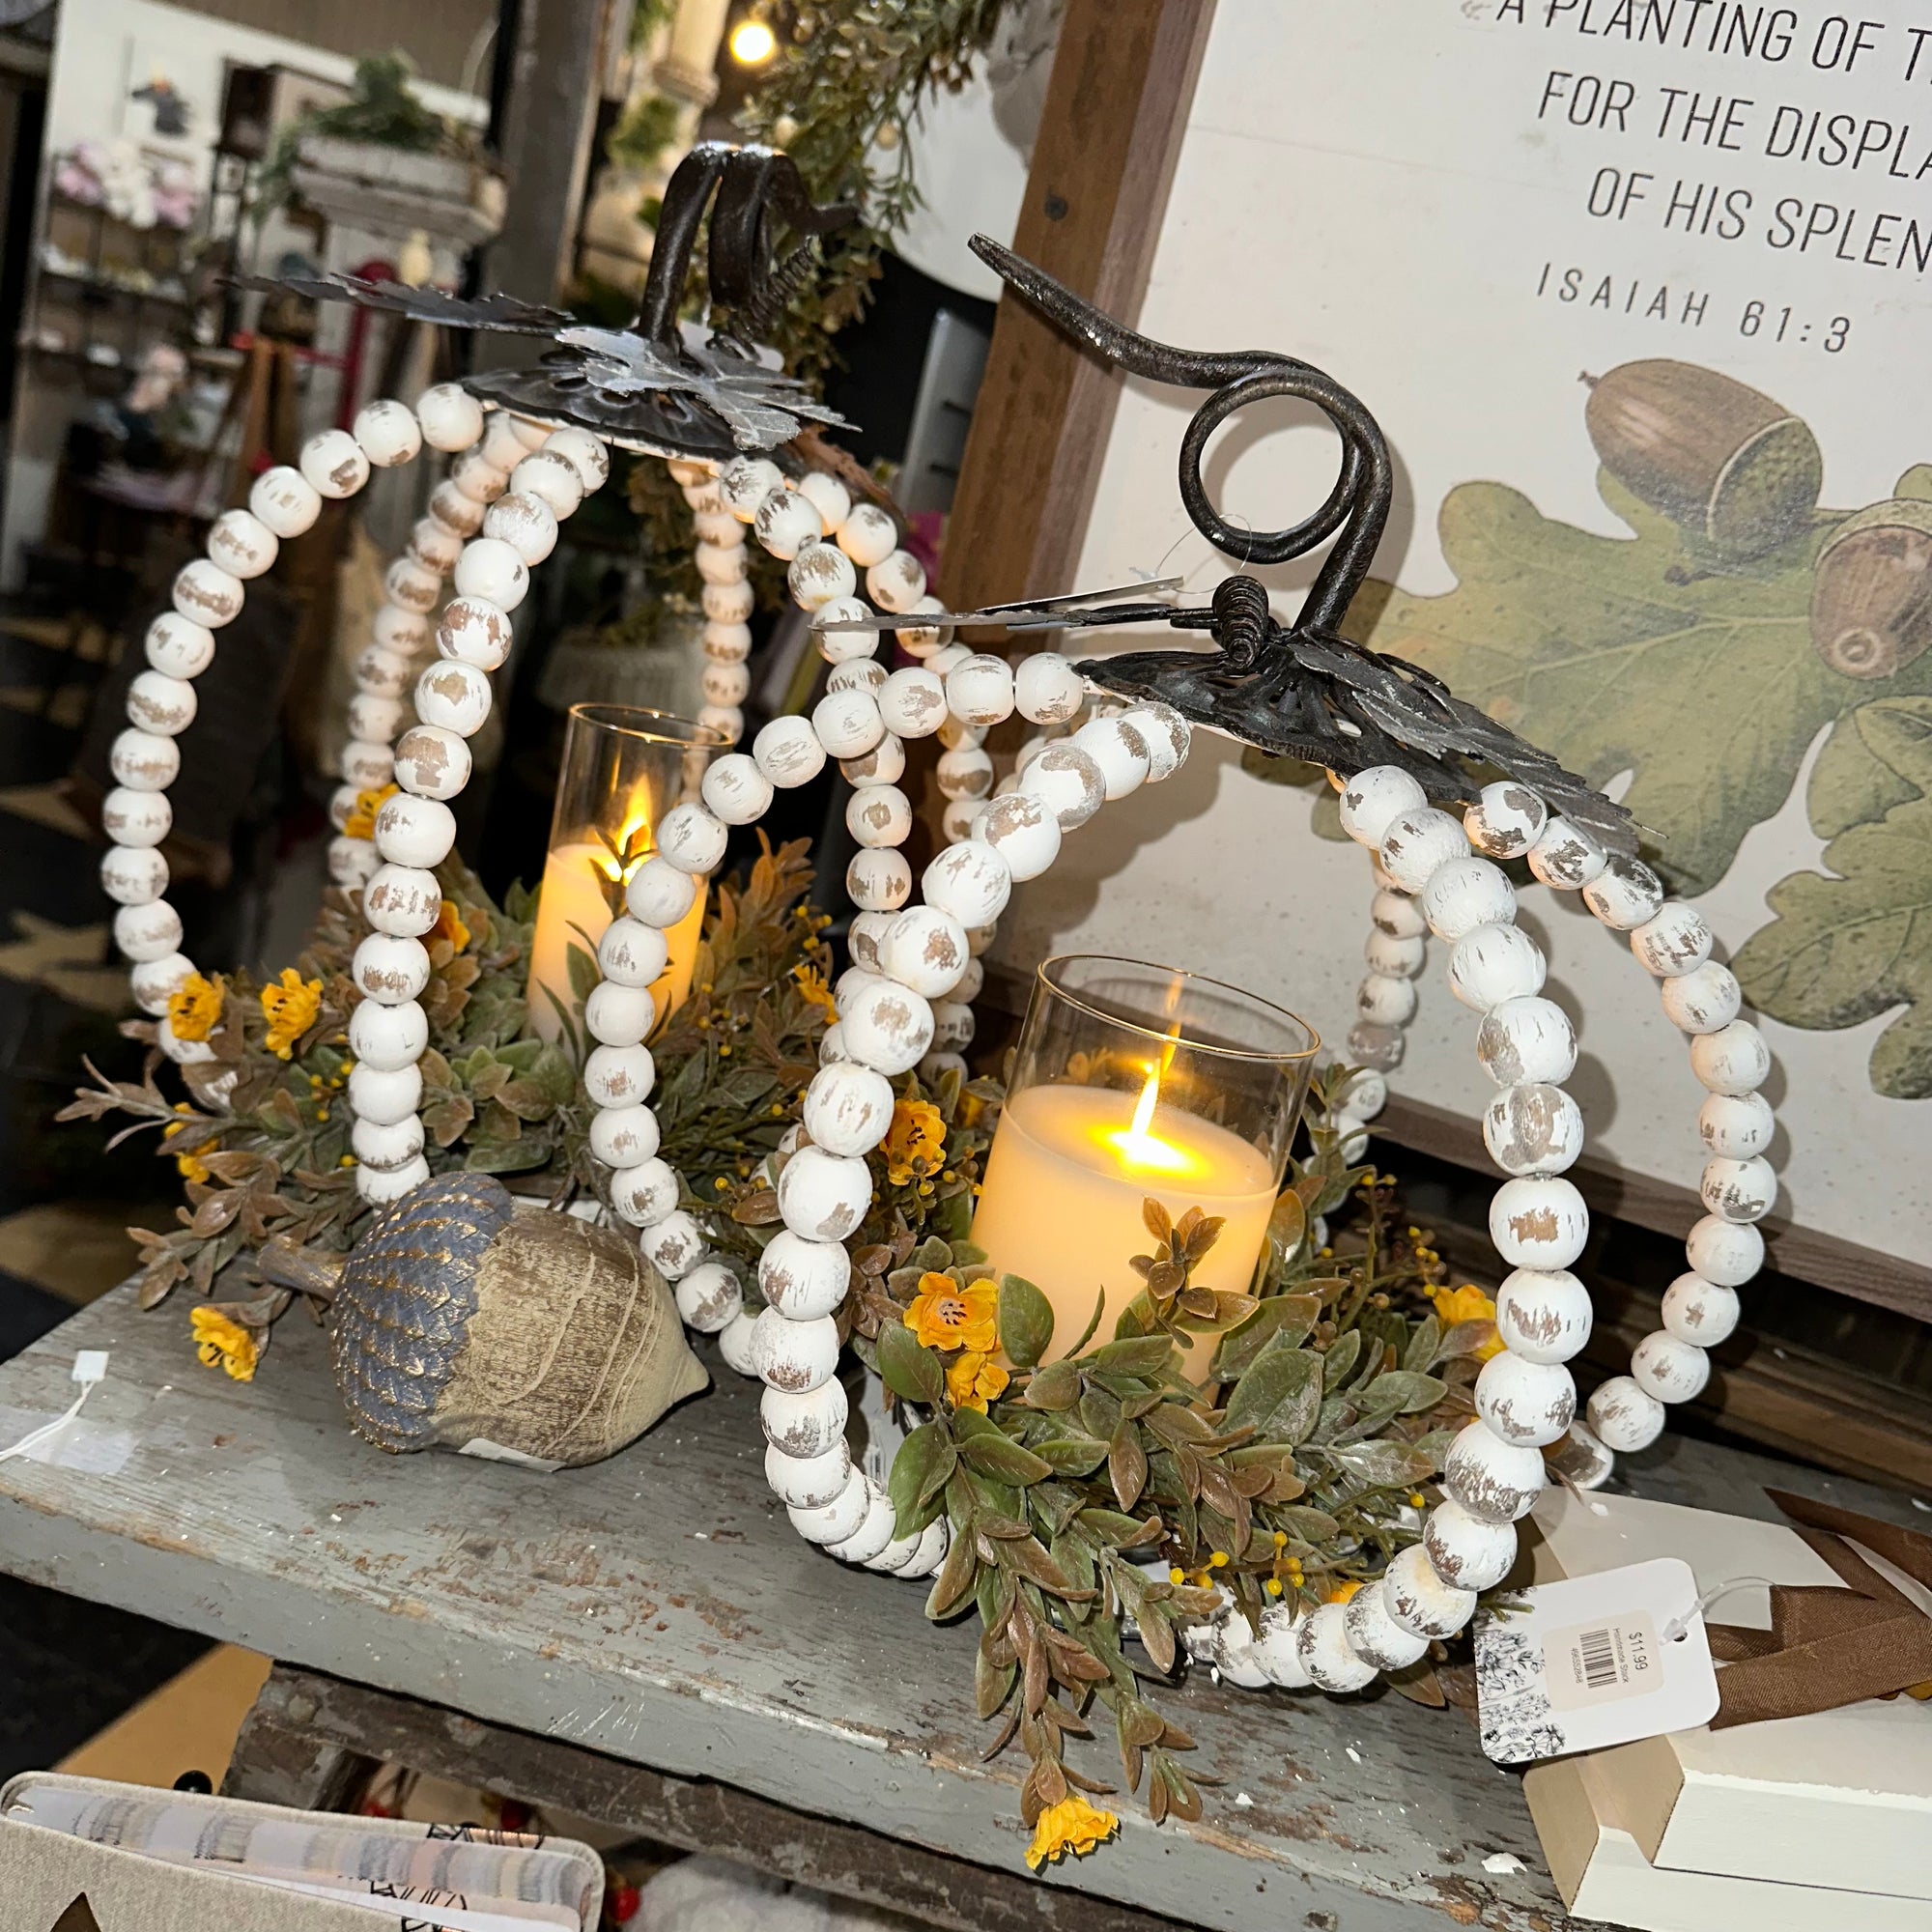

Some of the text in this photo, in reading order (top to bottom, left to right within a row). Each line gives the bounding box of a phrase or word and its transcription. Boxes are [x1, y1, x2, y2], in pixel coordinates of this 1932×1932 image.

[1545, 0, 1798, 62] PLANTING
[1811, 16, 1886, 72] OF
[1904, 27, 1932, 85] T
[1538, 71, 1635, 132] FOR
[1658, 87, 1754, 151] THE
[1587, 167, 1655, 220] OF
[1663, 180, 1752, 240] HIS
[1537, 263, 1850, 353] ISAIAH 61:3
[1629, 1632, 1648, 1670] $11.99
